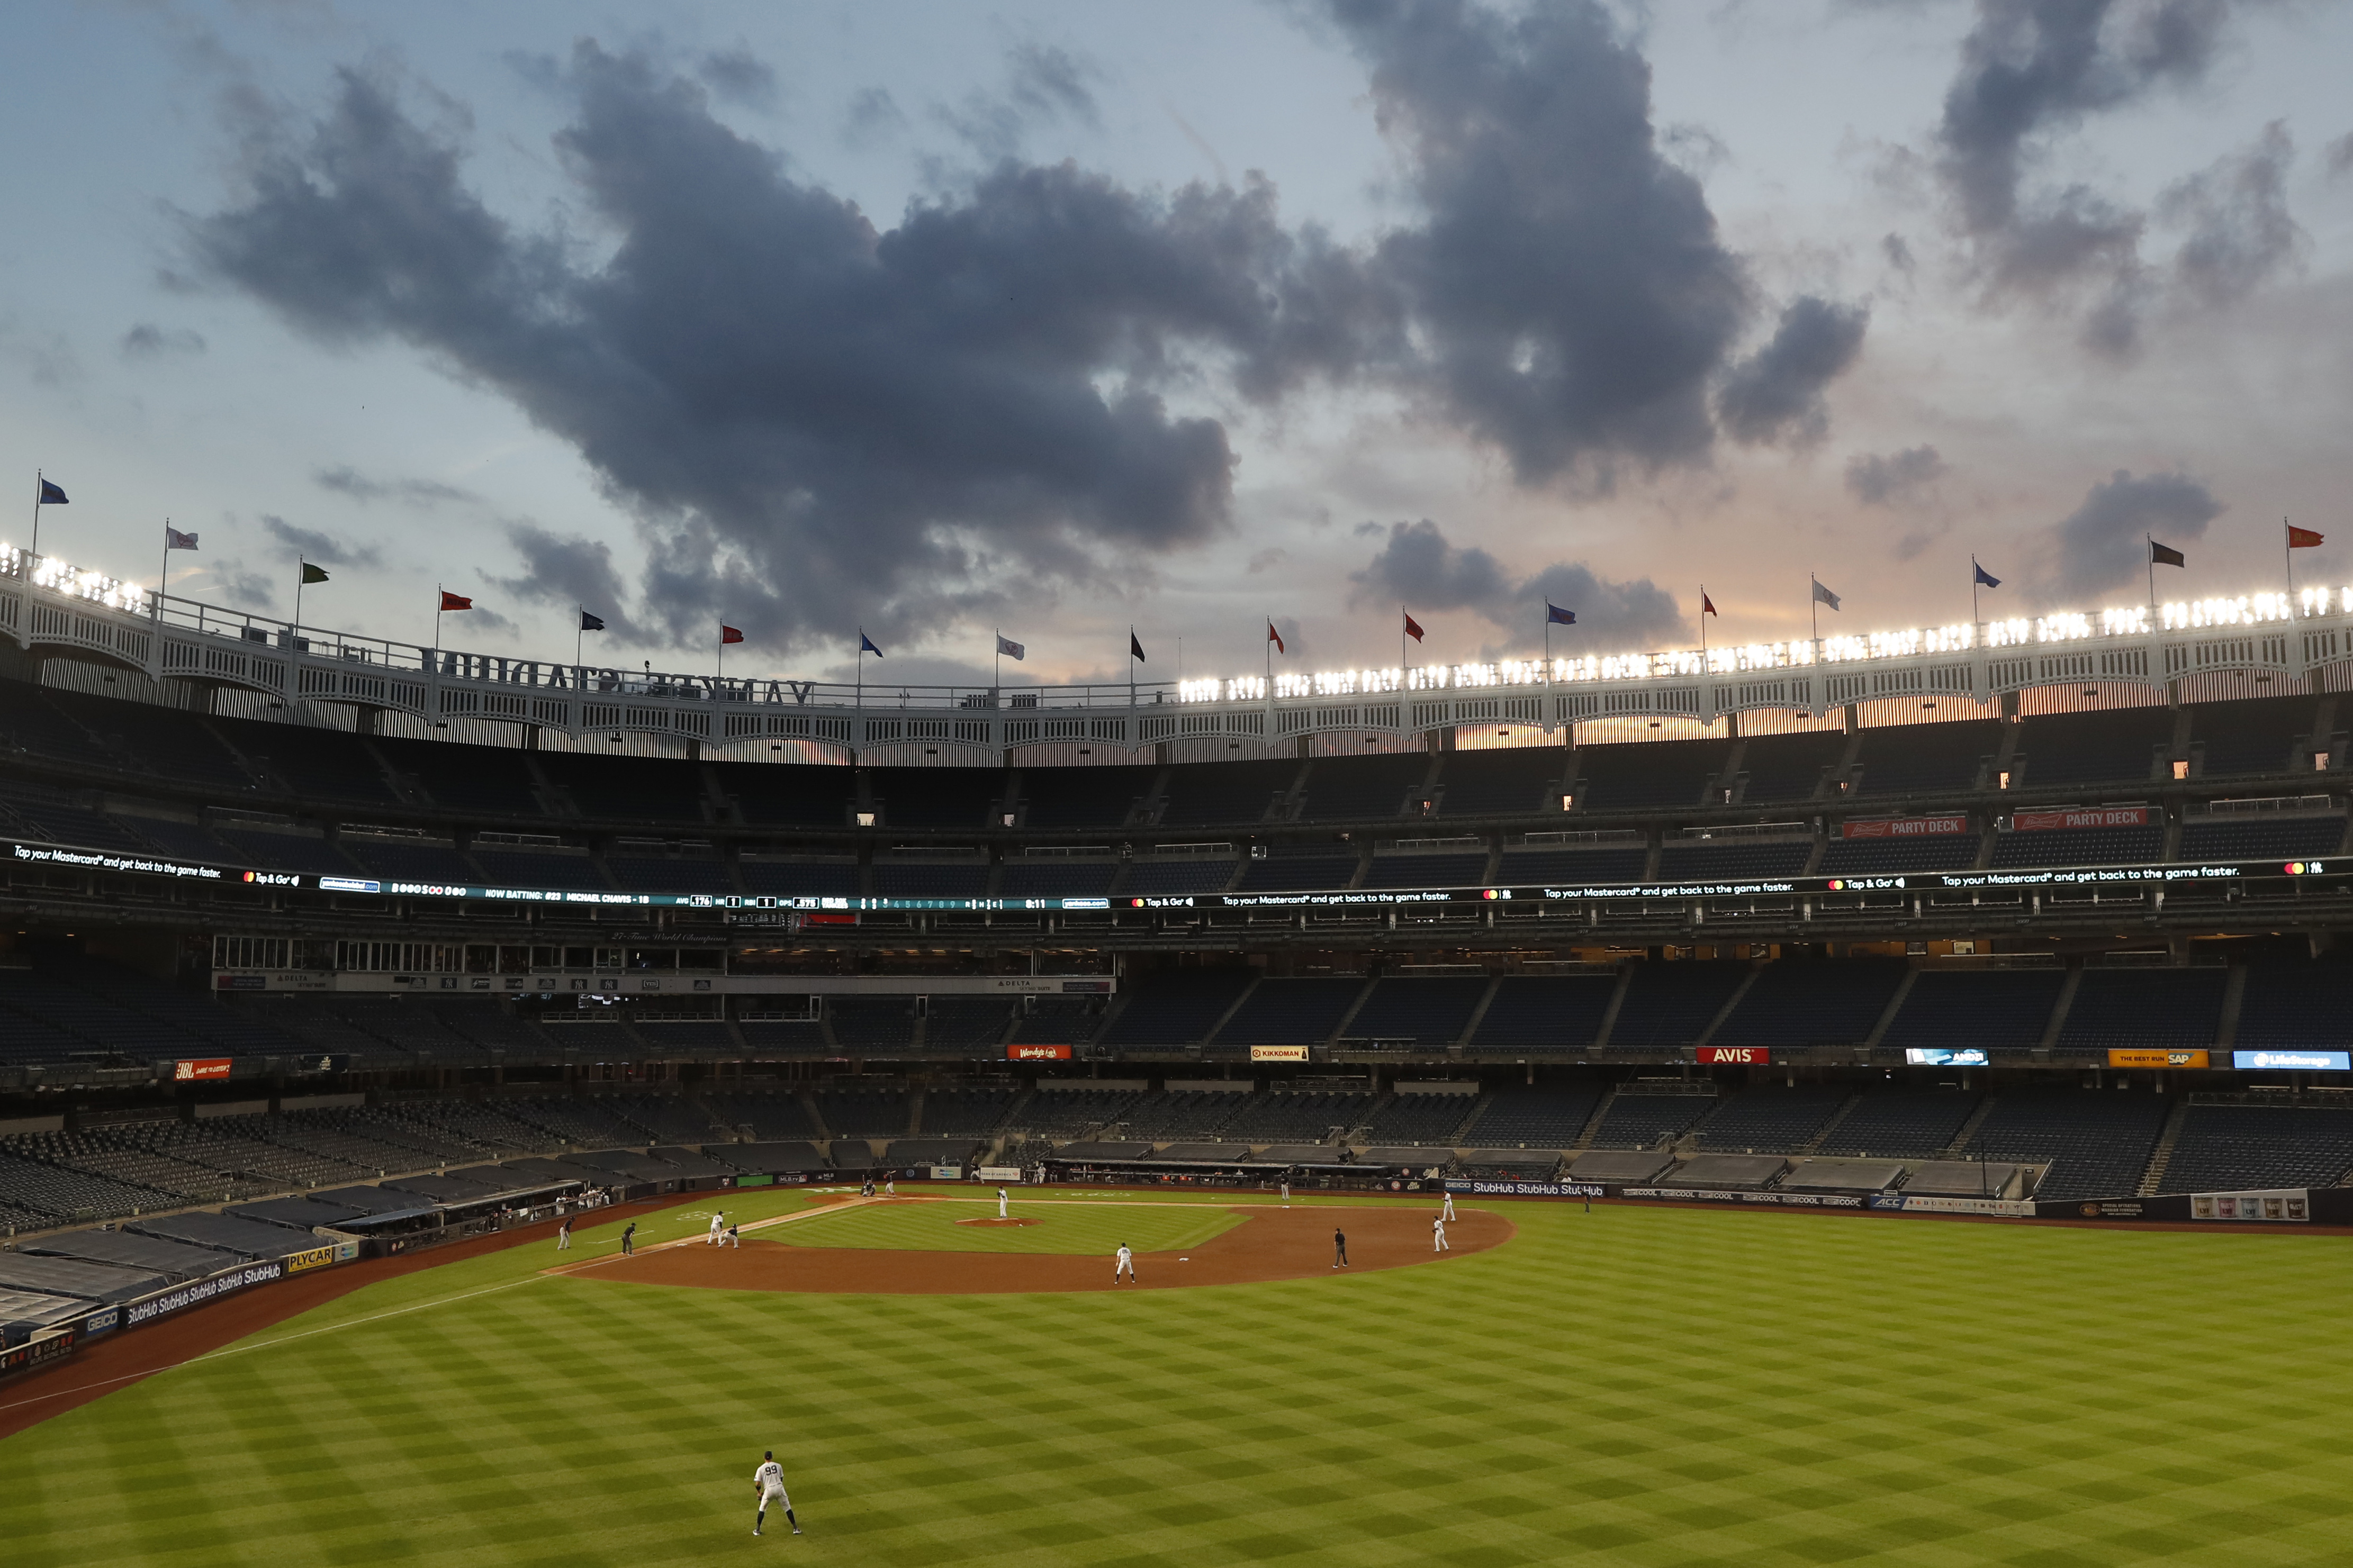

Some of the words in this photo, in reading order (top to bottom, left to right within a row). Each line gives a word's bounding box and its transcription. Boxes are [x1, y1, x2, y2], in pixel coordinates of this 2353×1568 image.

[2066, 813, 2103, 826] PARTY
[2106, 811, 2139, 823] DECK
[1892, 822, 1925, 834] PARTY
[1929, 820, 1958, 832] DECK
[14, 845, 30, 859] Tap
[31, 849, 51, 860] your
[103, 857, 120, 867] and
[119, 860, 134, 870] get
[134, 859, 153, 871] back
[154, 863, 163, 872] to
[164, 863, 176, 873] the
[177, 867, 198, 876] game
[199, 866, 221, 878] faster.
[256, 873, 267, 885] Tap
[267, 874, 274, 884] &
[1942, 876, 1961, 887] Tap
[1963, 877, 1985, 886] your
[2054, 872, 2075, 881] and
[2077, 872, 2096, 883] get
[2099, 870, 2125, 880] back
[2127, 870, 2141, 878] to
[2143, 868, 2162, 878] the
[2166, 870, 2198, 880] game
[2201, 866, 2240, 877] faster.
[391, 883, 399, 893] B
[421, 885, 429, 894] S
[1846, 880, 1864, 890] Tap
[1866, 879, 1874, 888] &
[485, 889, 506, 898] NOW
[506, 890, 543, 900] BATTING:
[545, 892, 561, 901] #23
[1544, 889, 1561, 899] Tap
[1563, 890, 1582, 899] your
[1642, 887, 1660, 896] and
[1662, 887, 1678, 897] get
[1680, 885, 1702, 895] back
[1716, 885, 1732, 893] the
[1734, 886, 1761, 895] game
[1763, 883, 1793, 892] faster.
[566, 893, 600, 902] MICHAEL
[602, 894, 632, 903] CHAVIS
[638, 895, 650, 904] 1B
[691, 896, 710, 905] .176
[731, 898, 735, 907] 1
[764, 898, 769, 907] 1
[797, 899, 816, 908] .575
[1025, 899, 1045, 909] 8:11
[1146, 898, 1161, 908] Tap
[1222, 896, 1239, 907] Tap
[1239, 898, 1258, 906] your
[1311, 894, 1327, 903] and
[1329, 895, 1344, 904] get
[1346, 894, 1366, 903] back
[1422, 892, 1452, 901] faster.
[612, 932, 650, 940] 27-Time
[683, 933, 727, 944] Champions
[1020, 1047, 1044, 1058] Wendy's
[1713, 1049, 1752, 1062] AVIS
[1953, 1053, 1976, 1062] AMD
[2168, 1055, 2189, 1064] SAP
[1473, 1183, 1514, 1193] StubHub
[1517, 1184, 1558, 1194] StubHub
[290, 1248, 331, 1267] PLYCAR
[305, 1260, 329, 1269] TRANSPORT
[128, 1301, 157, 1325] StubHub
[159, 1292, 188, 1313] StubHub
[190, 1280, 217, 1301] StubHub
[218, 1272, 243, 1293] StubHub
[245, 1264, 281, 1284] StubHub
[87, 1311, 118, 1331] GEICO
[765, 1465, 777, 1476] 99
